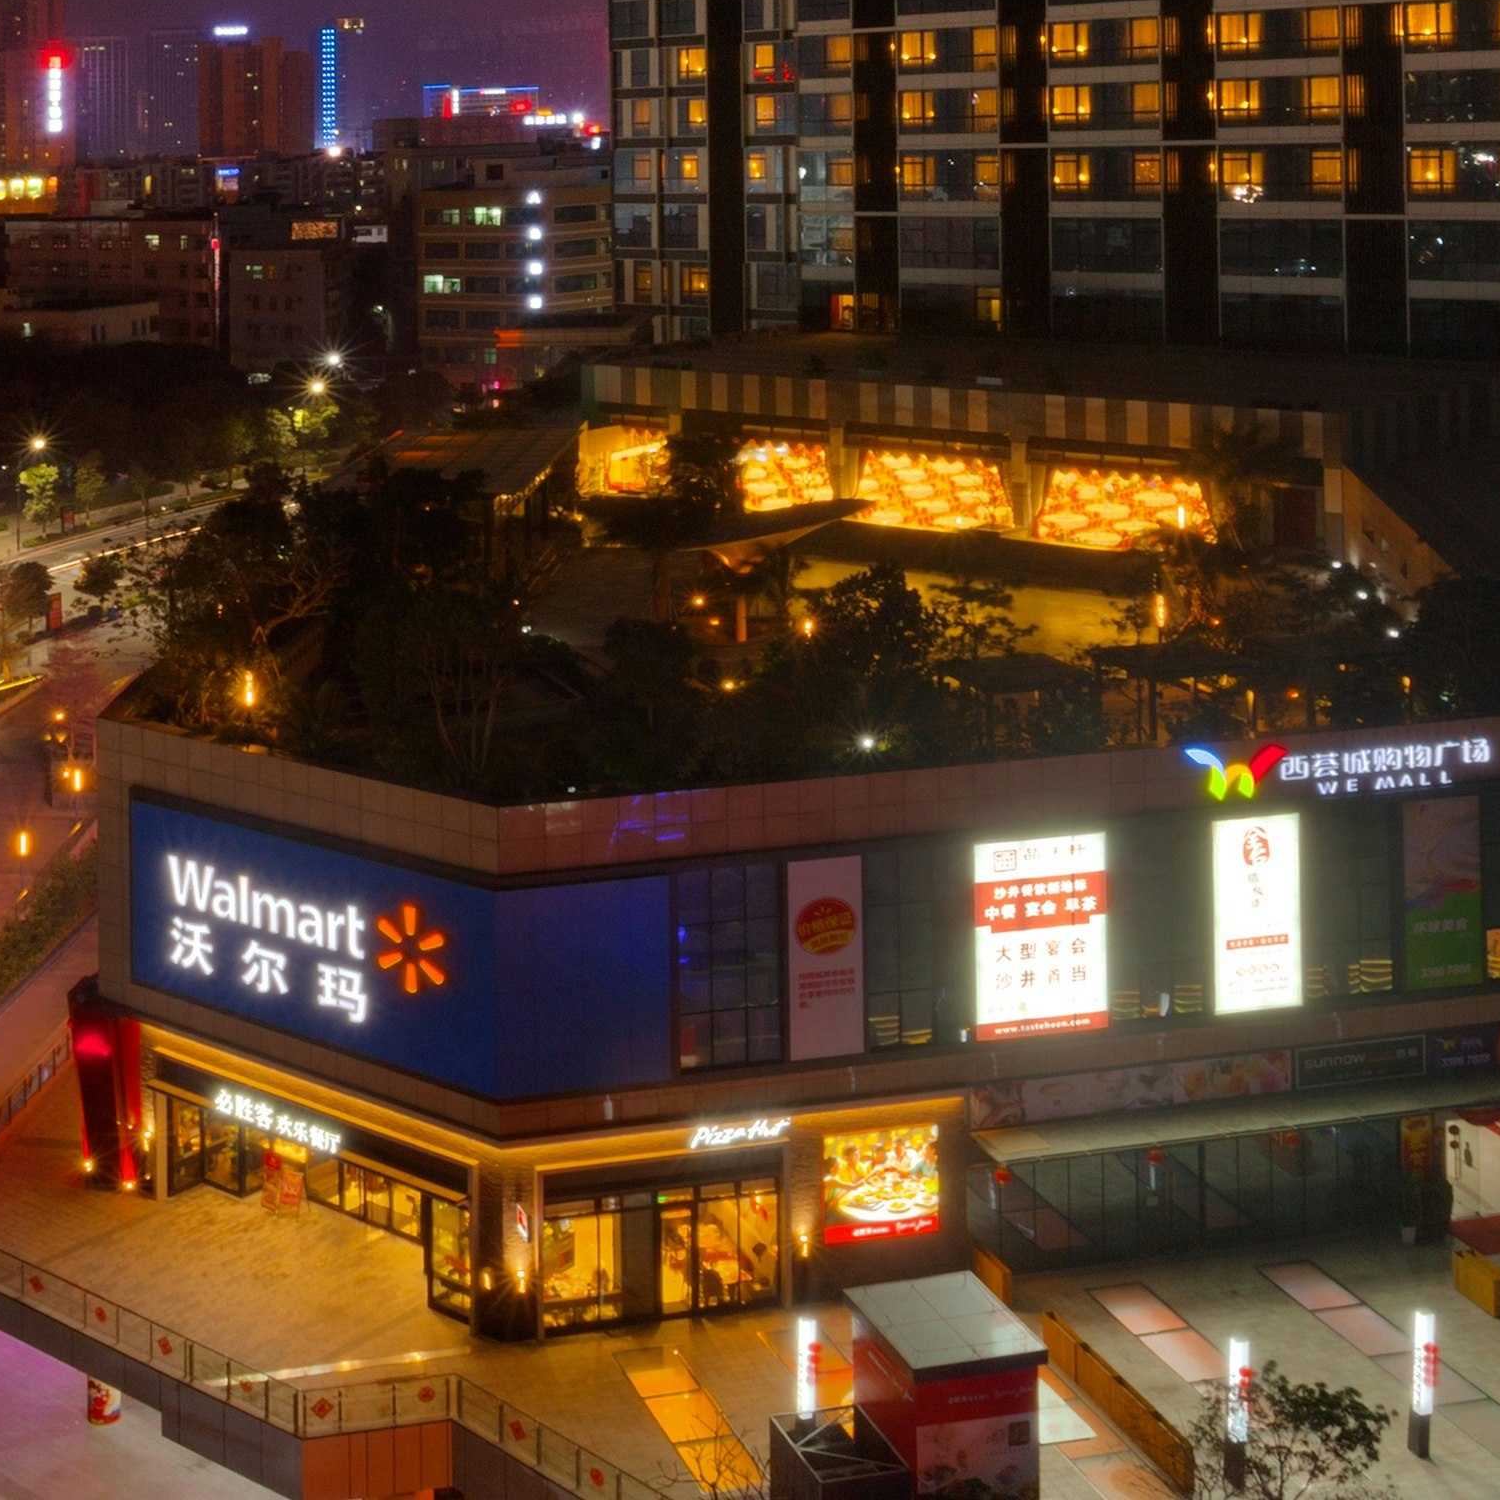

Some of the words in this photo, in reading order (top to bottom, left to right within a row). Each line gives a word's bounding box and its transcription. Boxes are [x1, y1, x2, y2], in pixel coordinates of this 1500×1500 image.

[1279, 738, 1491, 781] 西荟城购物广场
[1316, 779, 1359, 796] WE
[1375, 769, 1453, 791] MALL
[168, 855, 365, 961] Walmart
[984, 904, 1017, 921] 中餐
[169, 916, 368, 1024] 沃尔玛
[214, 1088, 274, 1130] 必胜客
[275, 1114, 341, 1154] 欢乐餐厅
[690, 1125, 747, 1149] Pizza
[747, 1118, 790, 1139] Hut
